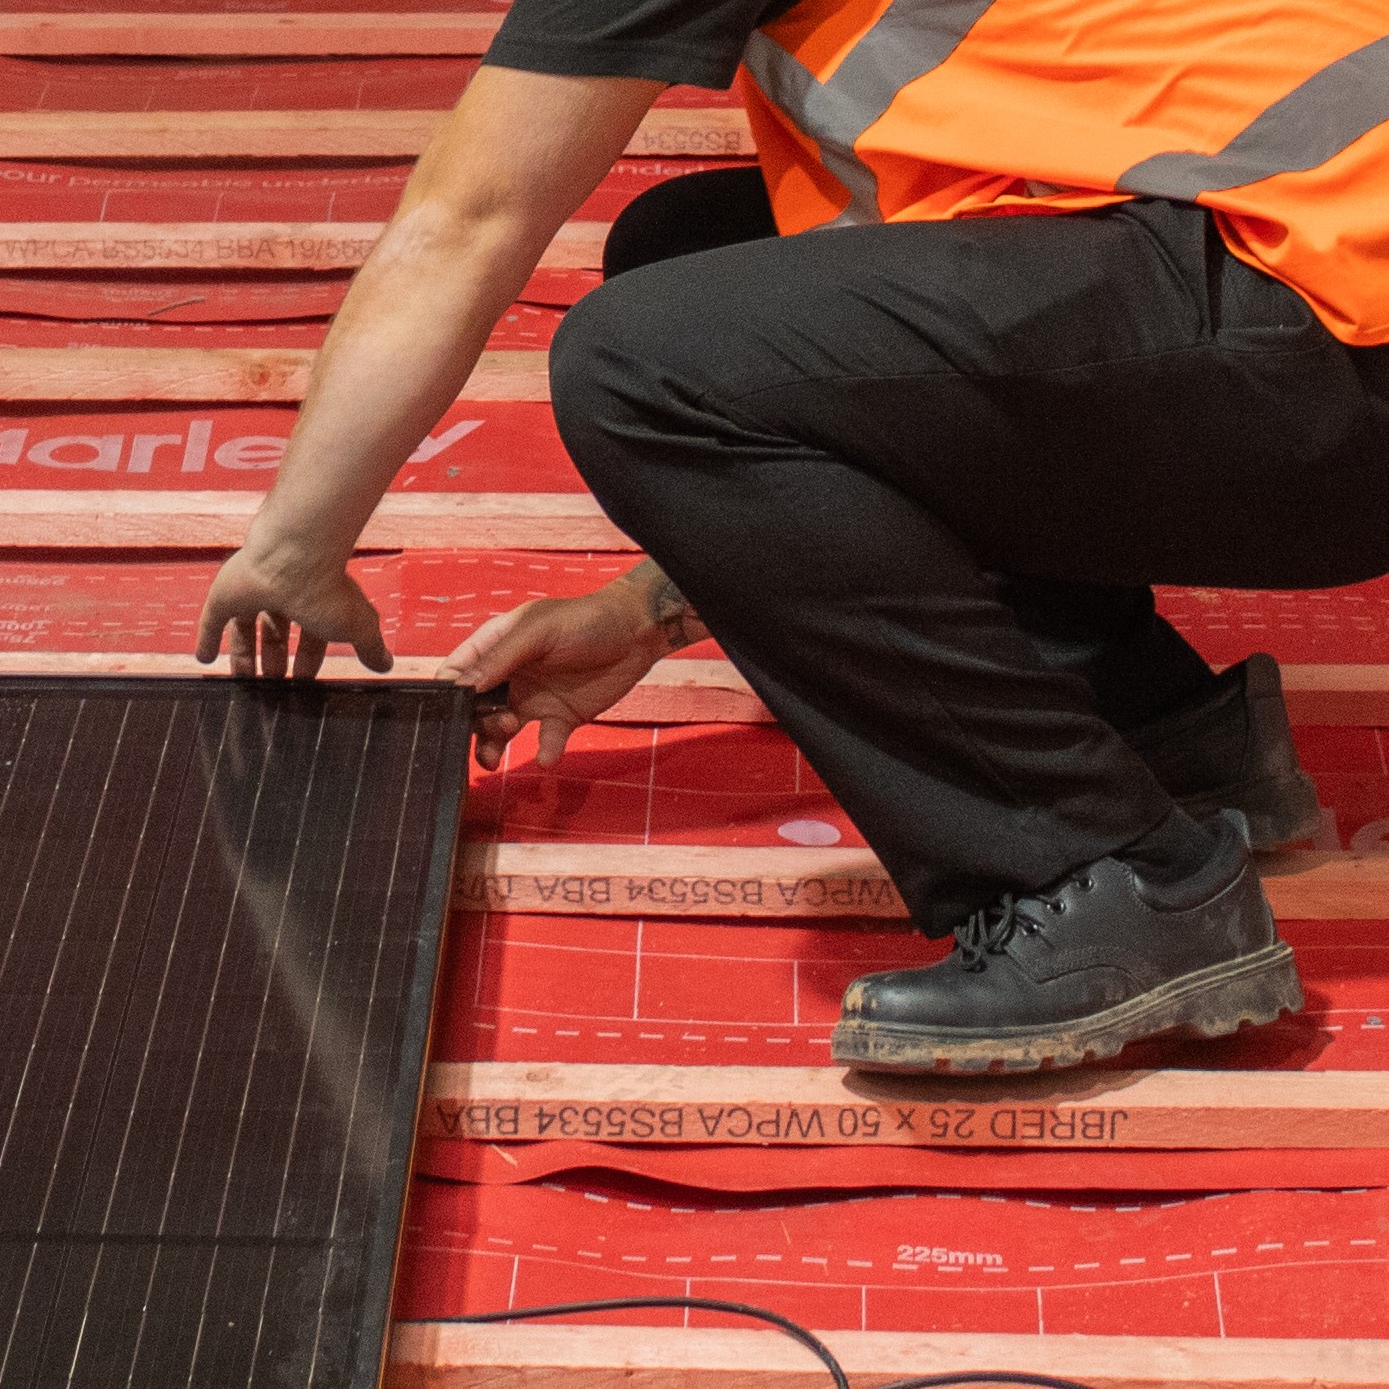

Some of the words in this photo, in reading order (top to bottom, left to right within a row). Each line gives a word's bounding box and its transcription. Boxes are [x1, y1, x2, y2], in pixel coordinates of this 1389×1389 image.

[215, 239, 277, 260] BBA
[536, 877, 610, 904] BBA
[626, 878, 764, 905] BS5534
[777, 880, 896, 907] WPCA
[438, 1105, 519, 1136] BBA
[534, 1106, 685, 1138] BS5534
[697, 1107, 826, 1139] WPCA
[837, 1108, 882, 1139] 50
[896, 1109, 916, 1131] x
[929, 1109, 975, 1140] 25
[989, 1109, 1129, 1141] JBRED
[896, 1244, 1004, 1266] 225mm
